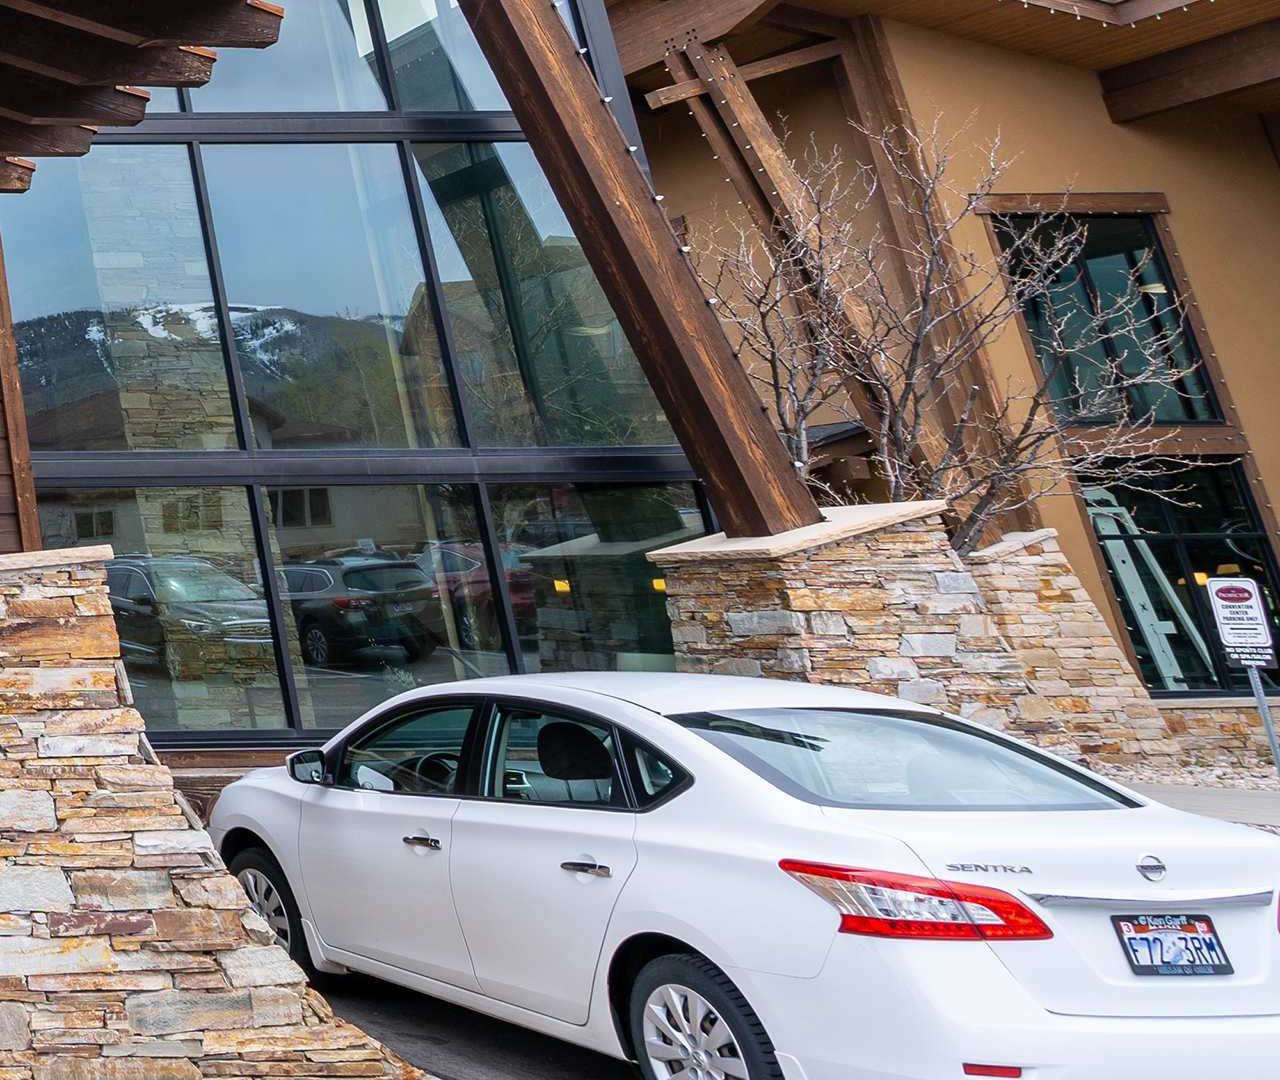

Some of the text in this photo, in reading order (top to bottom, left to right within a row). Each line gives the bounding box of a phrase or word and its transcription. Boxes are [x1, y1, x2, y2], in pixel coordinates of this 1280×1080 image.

[945, 863, 1033, 874] SENTRA
[1147, 916, 1166, 926] Ken
[1127, 936, 1225, 965] F72 3RM
